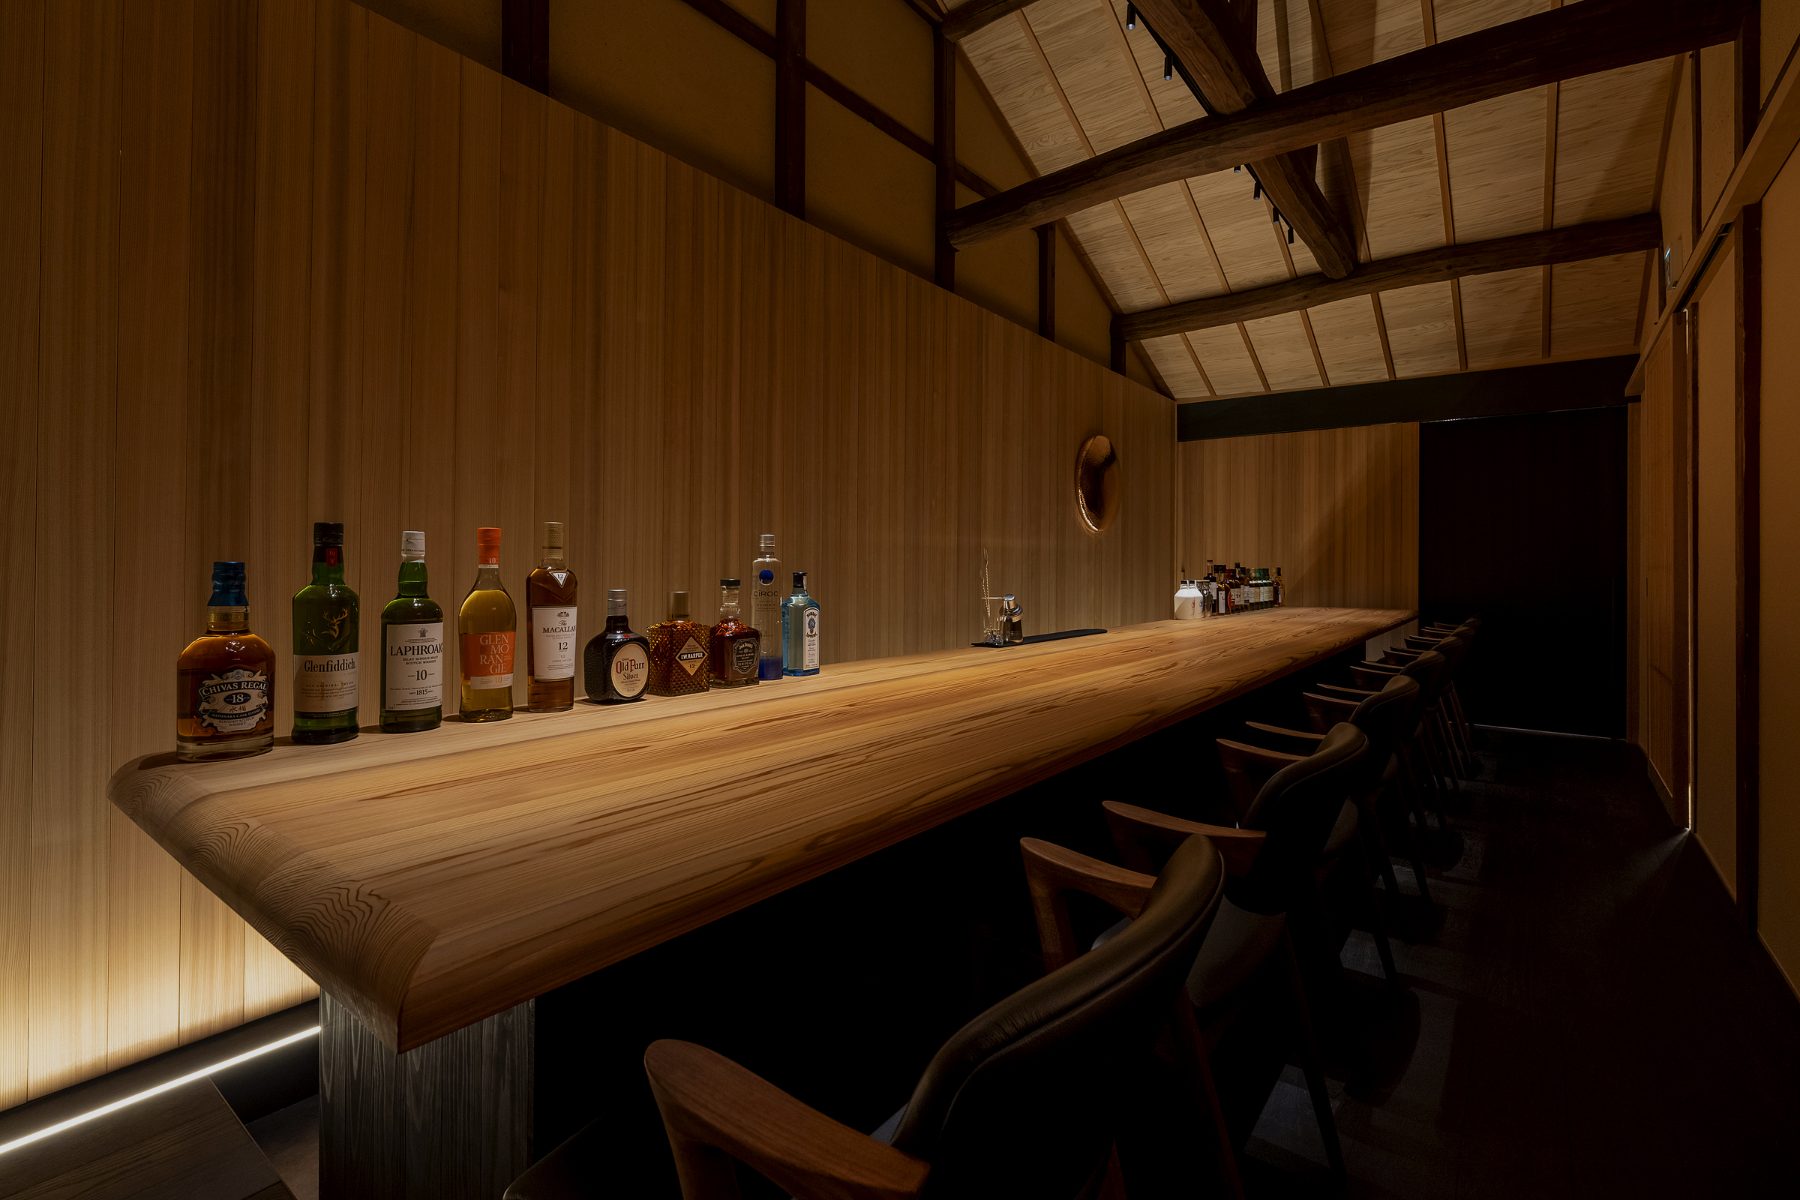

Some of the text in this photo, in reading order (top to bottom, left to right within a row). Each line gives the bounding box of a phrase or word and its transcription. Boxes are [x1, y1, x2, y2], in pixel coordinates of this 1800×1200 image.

[479, 634, 509, 645] GLEN
[490, 643, 510, 654] MO
[559, 642, 568, 650] 12
[304, 657, 356, 672] Glenfiddich
[480, 654, 504, 665] RAN
[616, 658, 645, 674] Old Parr
[416, 669, 428, 681] 10
[202, 681, 267, 695] CHIVAS REGAL
[231, 693, 244, 704] 18
